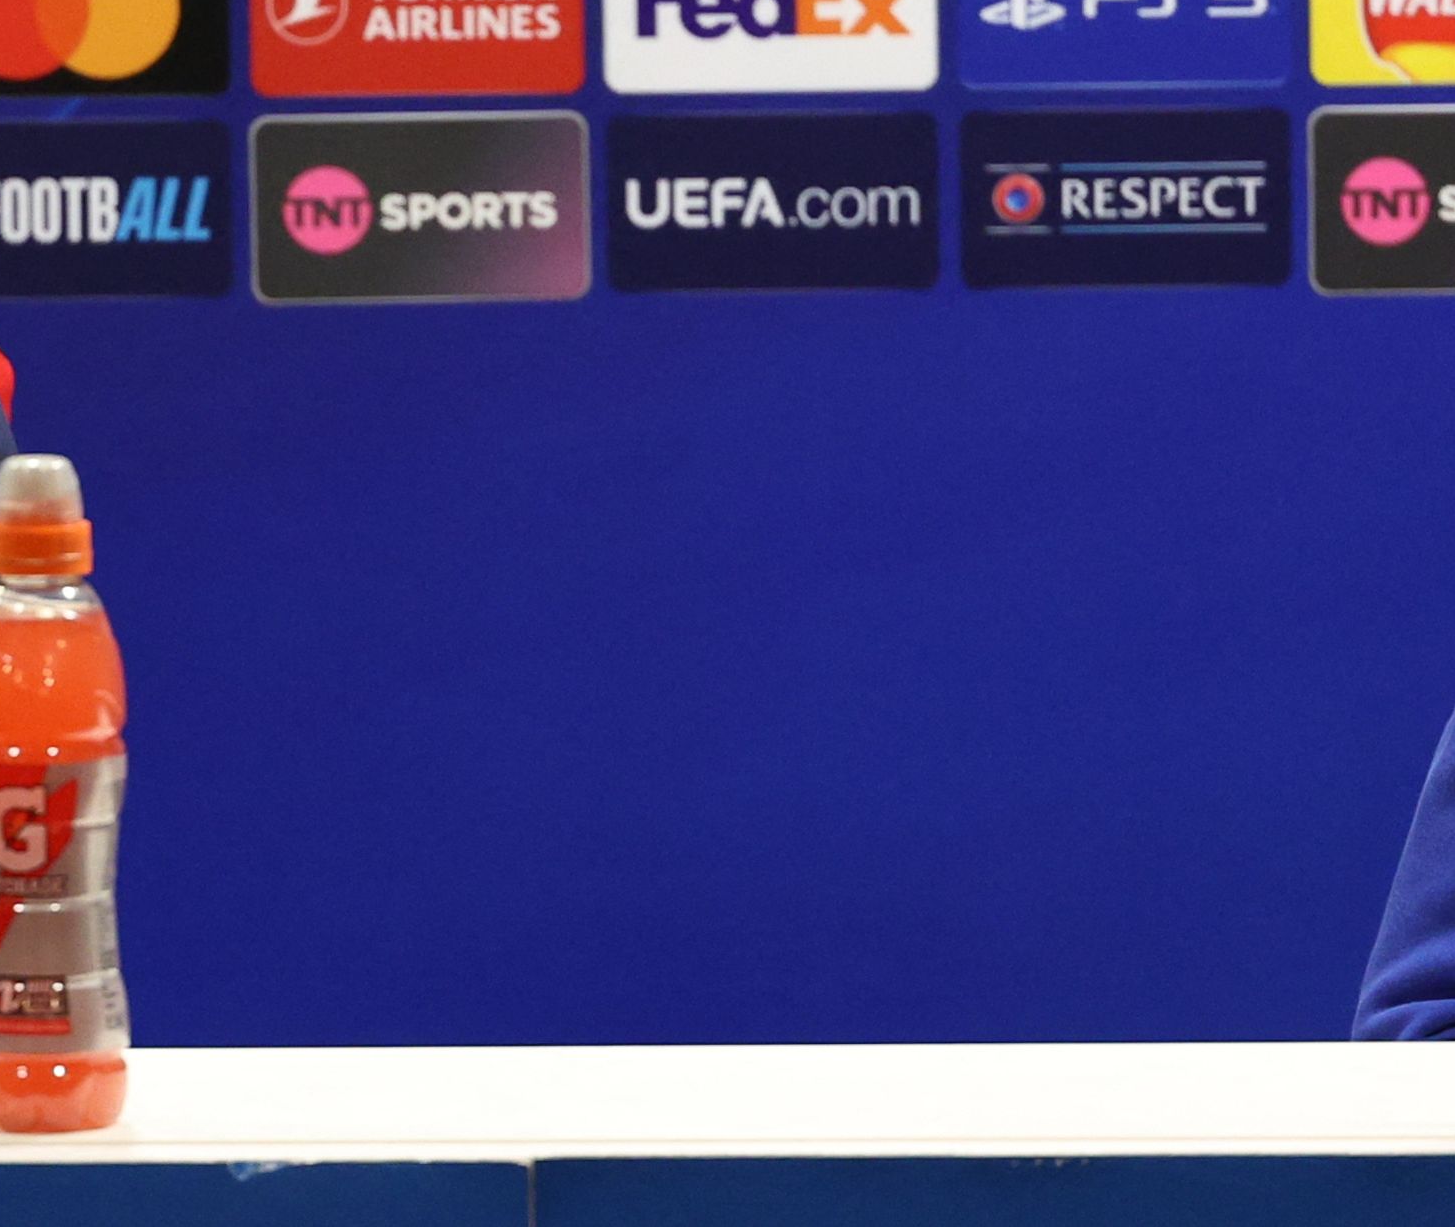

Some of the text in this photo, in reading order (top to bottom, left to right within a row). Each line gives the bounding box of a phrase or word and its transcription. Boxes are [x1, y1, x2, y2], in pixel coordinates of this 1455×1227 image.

[364, 3, 561, 41] AIRLINES
[288, 190, 558, 231] TNT SPORTS
[625, 177, 920, 229] UEFA.com
[1061, 176, 1265, 219] RESPECT
[1344, 186, 1429, 222] TNT
